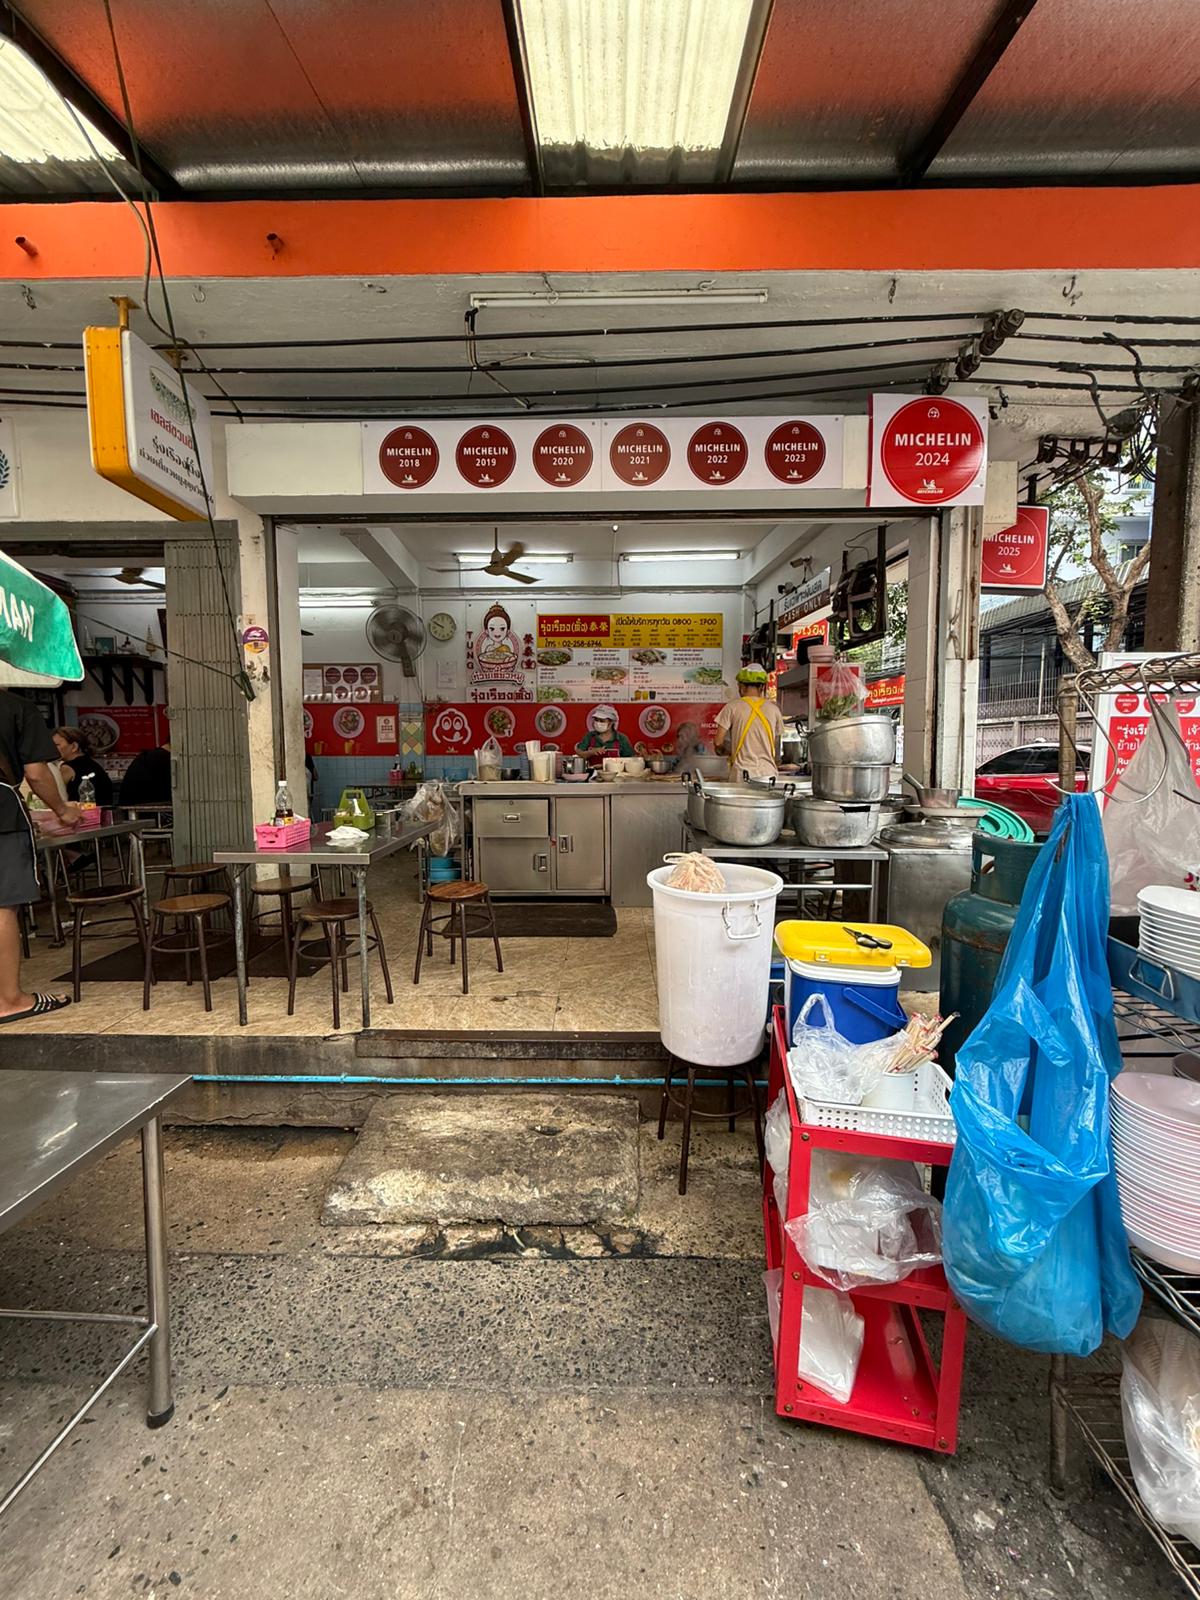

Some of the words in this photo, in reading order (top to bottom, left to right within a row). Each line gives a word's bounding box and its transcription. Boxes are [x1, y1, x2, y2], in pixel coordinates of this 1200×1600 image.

[894, 432, 972, 447] MICHELIN
[463, 446, 509, 456] MICHELIN
[540, 445, 586, 455] MICHELIN
[617, 444, 663, 454] MICHELIN
[694, 443, 741, 452] MICHELIN
[772, 442, 819, 451] MICHELIN
[386, 447, 432, 457] MICHELIN
[399, 458, 420, 467] 2018
[475, 457, 497, 467] 2019
[552, 457, 574, 466] 2020
[629, 456, 650, 465] 2021
[707, 455, 728, 464] 2022
[784, 453, 806, 463] 2023
[914, 452, 950, 466] 2024
[997, 546, 1021, 556] 2025
[783, 607, 800, 623] CASH
[804, 596, 822, 613] ONLY
[466, 631, 474, 670] TUNG
